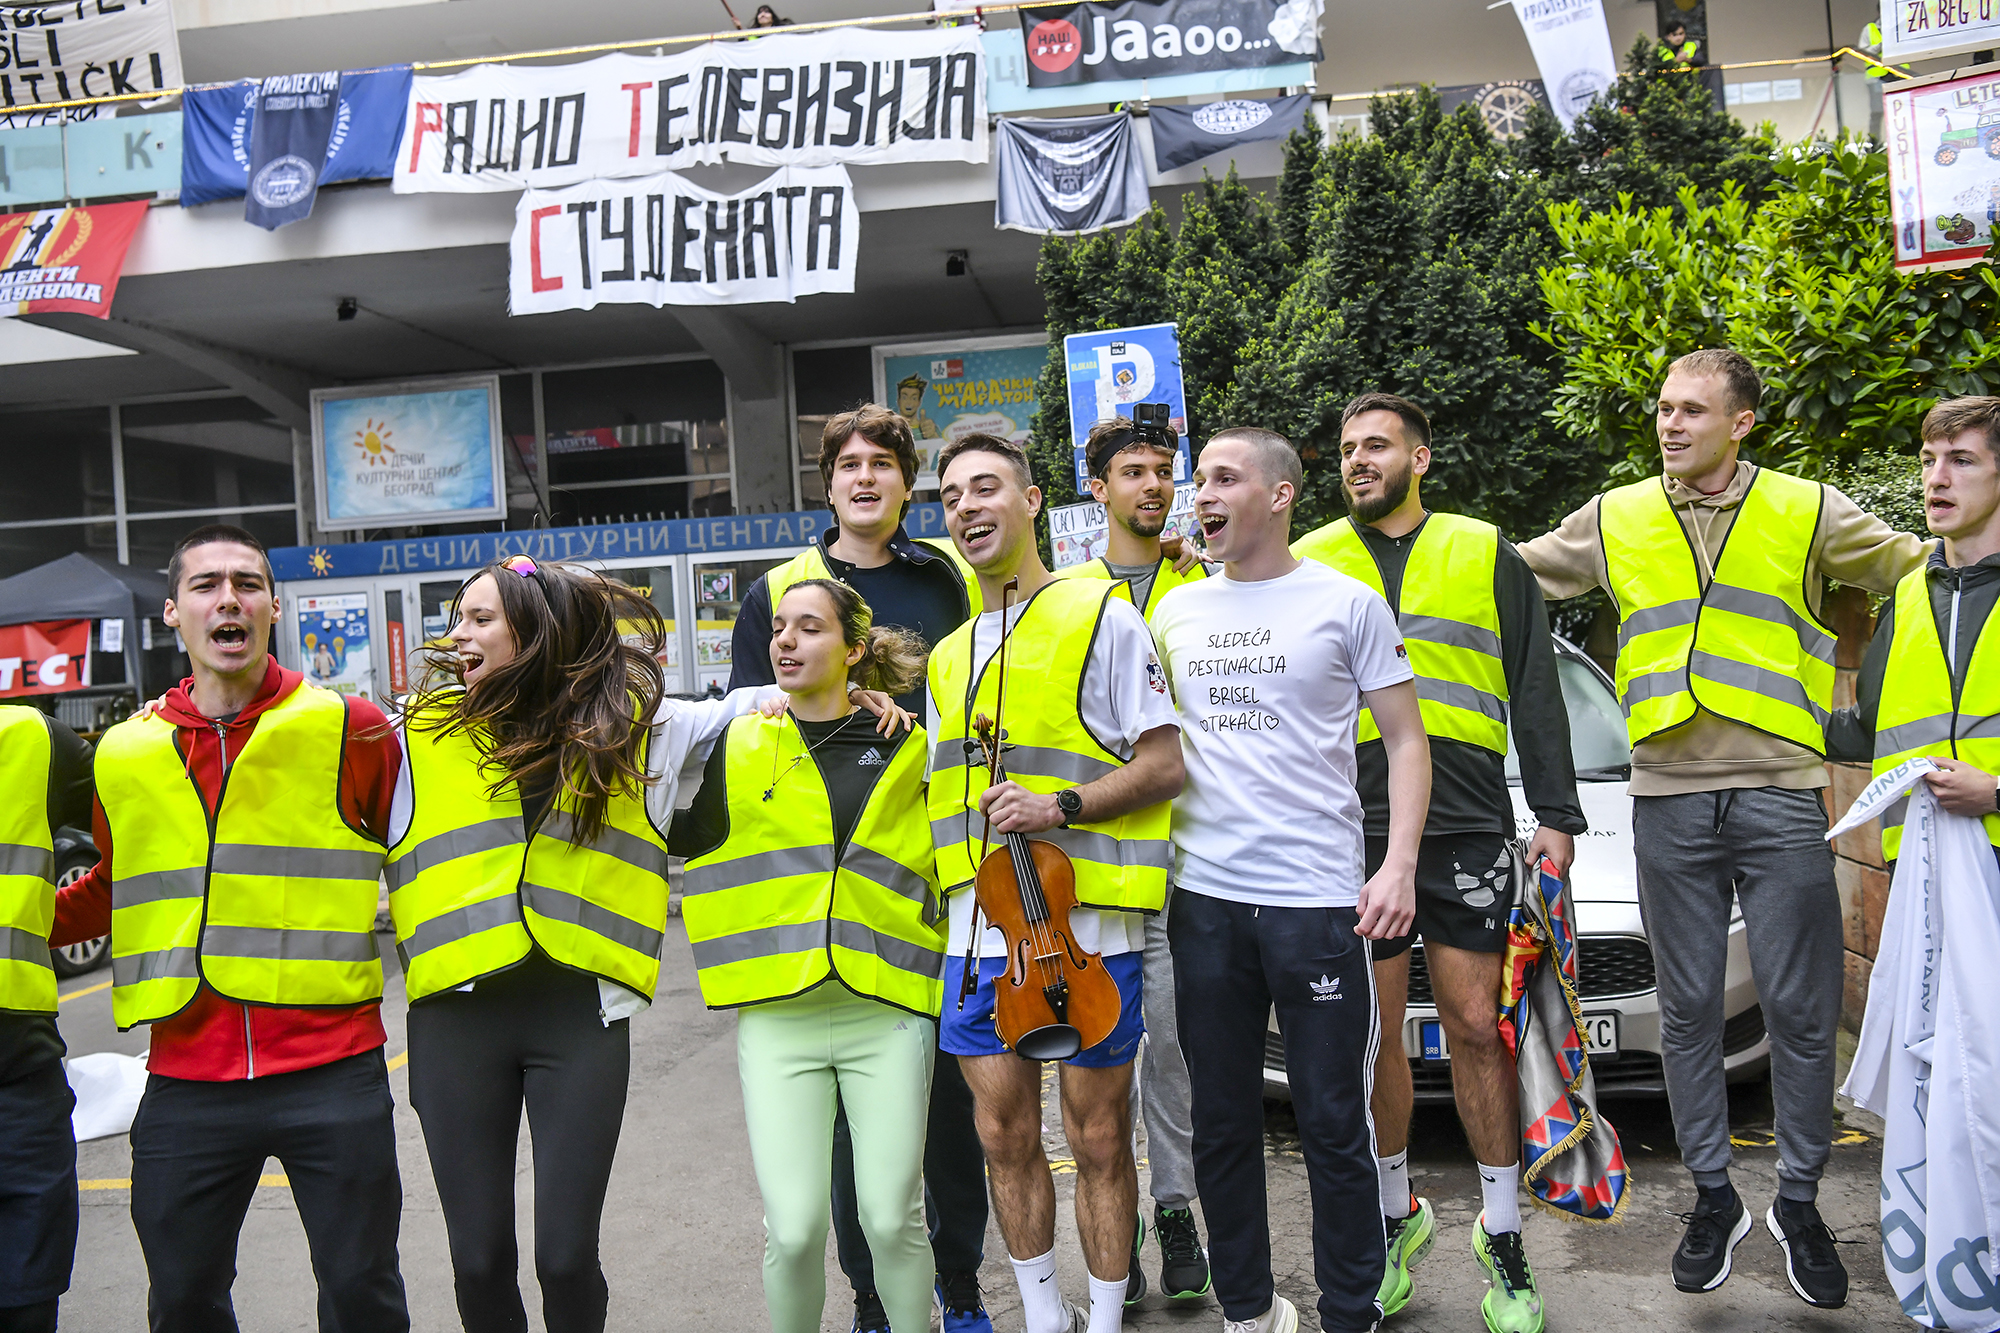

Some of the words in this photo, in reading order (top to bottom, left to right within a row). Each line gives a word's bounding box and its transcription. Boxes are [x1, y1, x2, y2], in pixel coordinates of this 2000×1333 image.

[1908, 1, 1929, 33] ZA
[1038, 32, 1071, 45] НАШ
[409, 92, 585, 173] РАДИО
[621, 52, 977, 157] ТЕЛЕВИЗИЈА
[530, 185, 843, 293] СТУДЕНАТА
[391, 453, 425, 469] ДЕЧЈИ
[356, 469, 415, 485] КУЛТУРНИ
[419, 464, 463, 481] ЦЕНТАР
[384, 482, 436, 498] БЕОГРАД
[379, 539, 481, 573] ДЕЧЈИ
[495, 526, 670, 559] КУЛТУРНИ
[685, 516, 816, 551] ЦЕНТАР
[1207, 627, 1271, 648] SLEDEĆA
[1188, 655, 1287, 677] DESTINACIJA
[1209, 686, 1260, 705] BRISEL
[1312, 993, 1343, 1002] adidas
[1425, 1046, 1439, 1055] SRB
